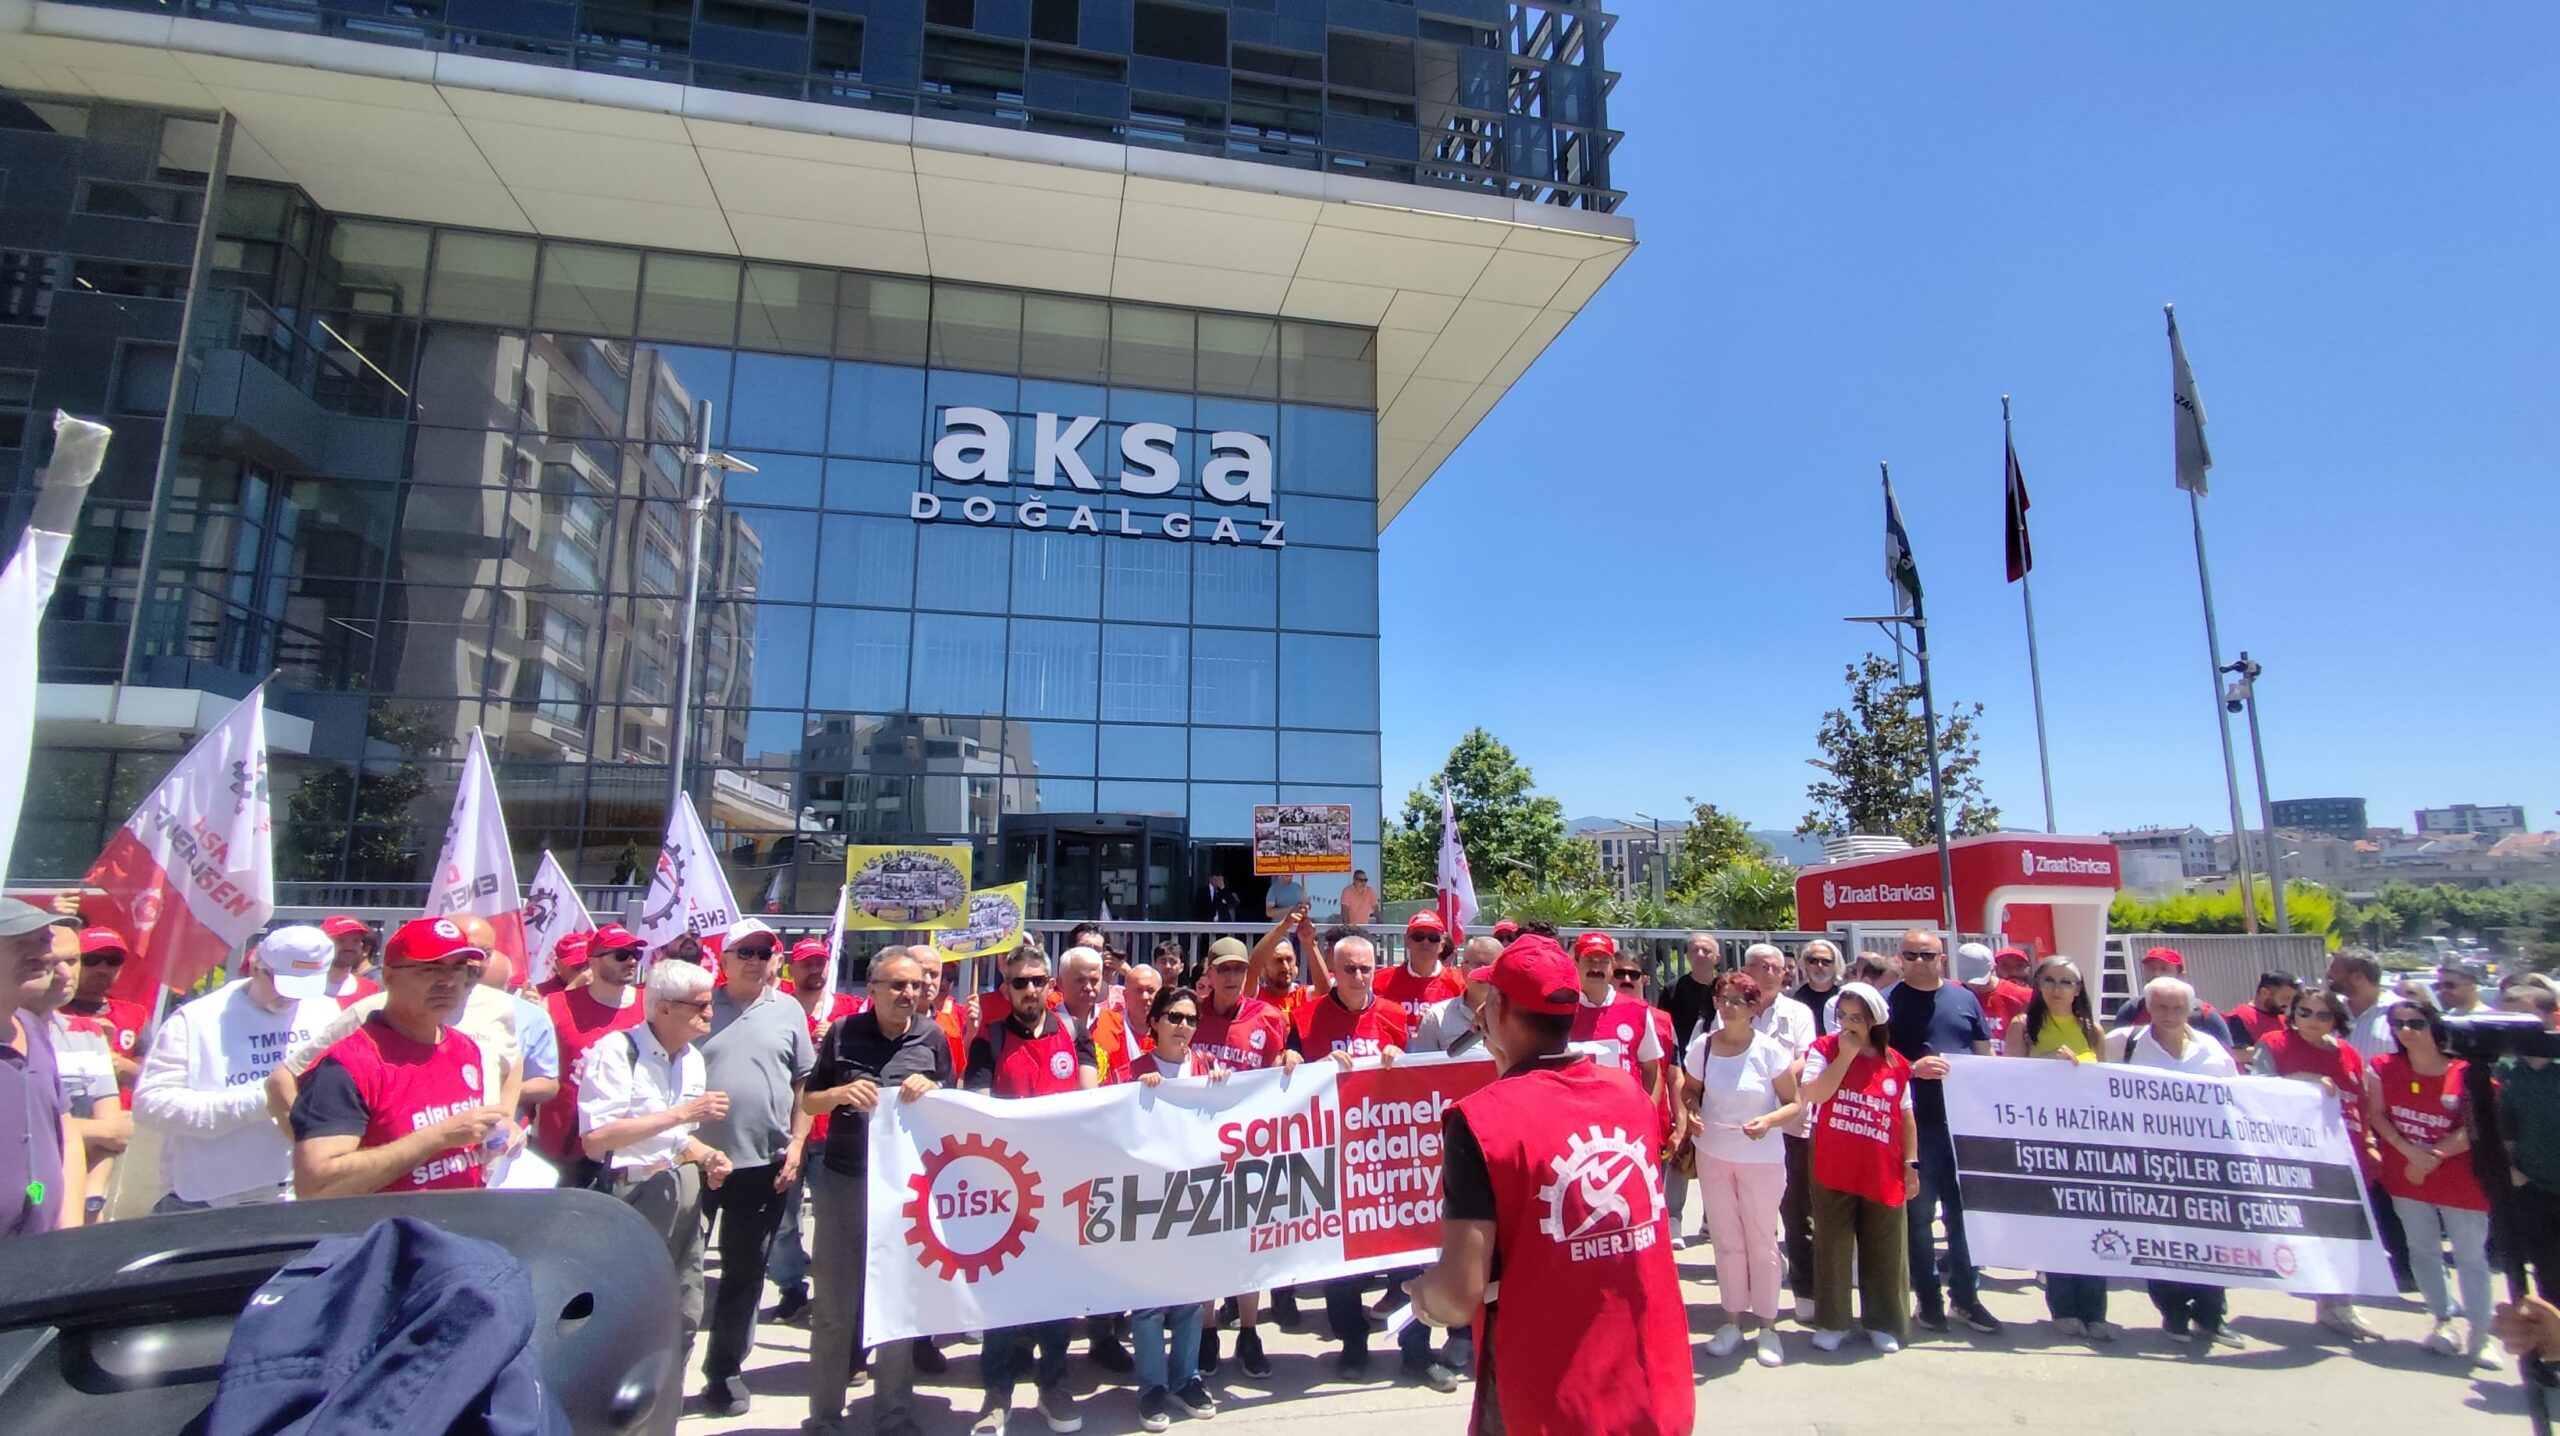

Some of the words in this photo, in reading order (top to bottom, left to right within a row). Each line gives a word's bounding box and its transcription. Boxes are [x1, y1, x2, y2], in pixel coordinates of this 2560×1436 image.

[933, 406, 1273, 504] aksa
[910, 491, 1286, 547] DOĞALGAZ
[2035, 855, 2068, 873] Ziraat
[2069, 856, 2111, 874] Bankası
[1839, 885, 1878, 903] Ziraat
[1880, 883, 1936, 902] Bankası
[1401, 997, 1430, 1016] DİS
[248, 1029, 311, 1049] TMMOB
[1331, 1035, 1380, 1055] DİSK
[251, 1051, 283, 1065] BUR
[225, 1070, 270, 1087] KOOP
[2109, 1077, 2234, 1106] BURSAGAZ'DA
[1832, 1102, 1875, 1122] METAL
[1994, 1103, 2048, 1127] 15-16
[2056, 1105, 2134, 1132] HAZİRAN
[2143, 1113, 2234, 1140] RUHUYLA
[2236, 1117, 2318, 1148] DİRENİYORUZ!
[1218, 1095, 1335, 1174] şanlı
[1346, 1159, 1444, 1199] hürriy
[2015, 1141, 2069, 1172] İŞTEN
[2075, 1150, 2137, 1175] ATILAN
[2143, 1150, 2221, 1183] İŞÇİLER
[2226, 1158, 2264, 1185] GERİ
[936, 1180, 1012, 1220] DİSK
[1348, 1197, 1443, 1234] müca
[2052, 1186, 2106, 1213] YETKİ
[2110, 1187, 2177, 1218] İTİRAZI
[2184, 1196, 2232, 1223] GERİ
[1250, 1207, 1341, 1253] izinde
